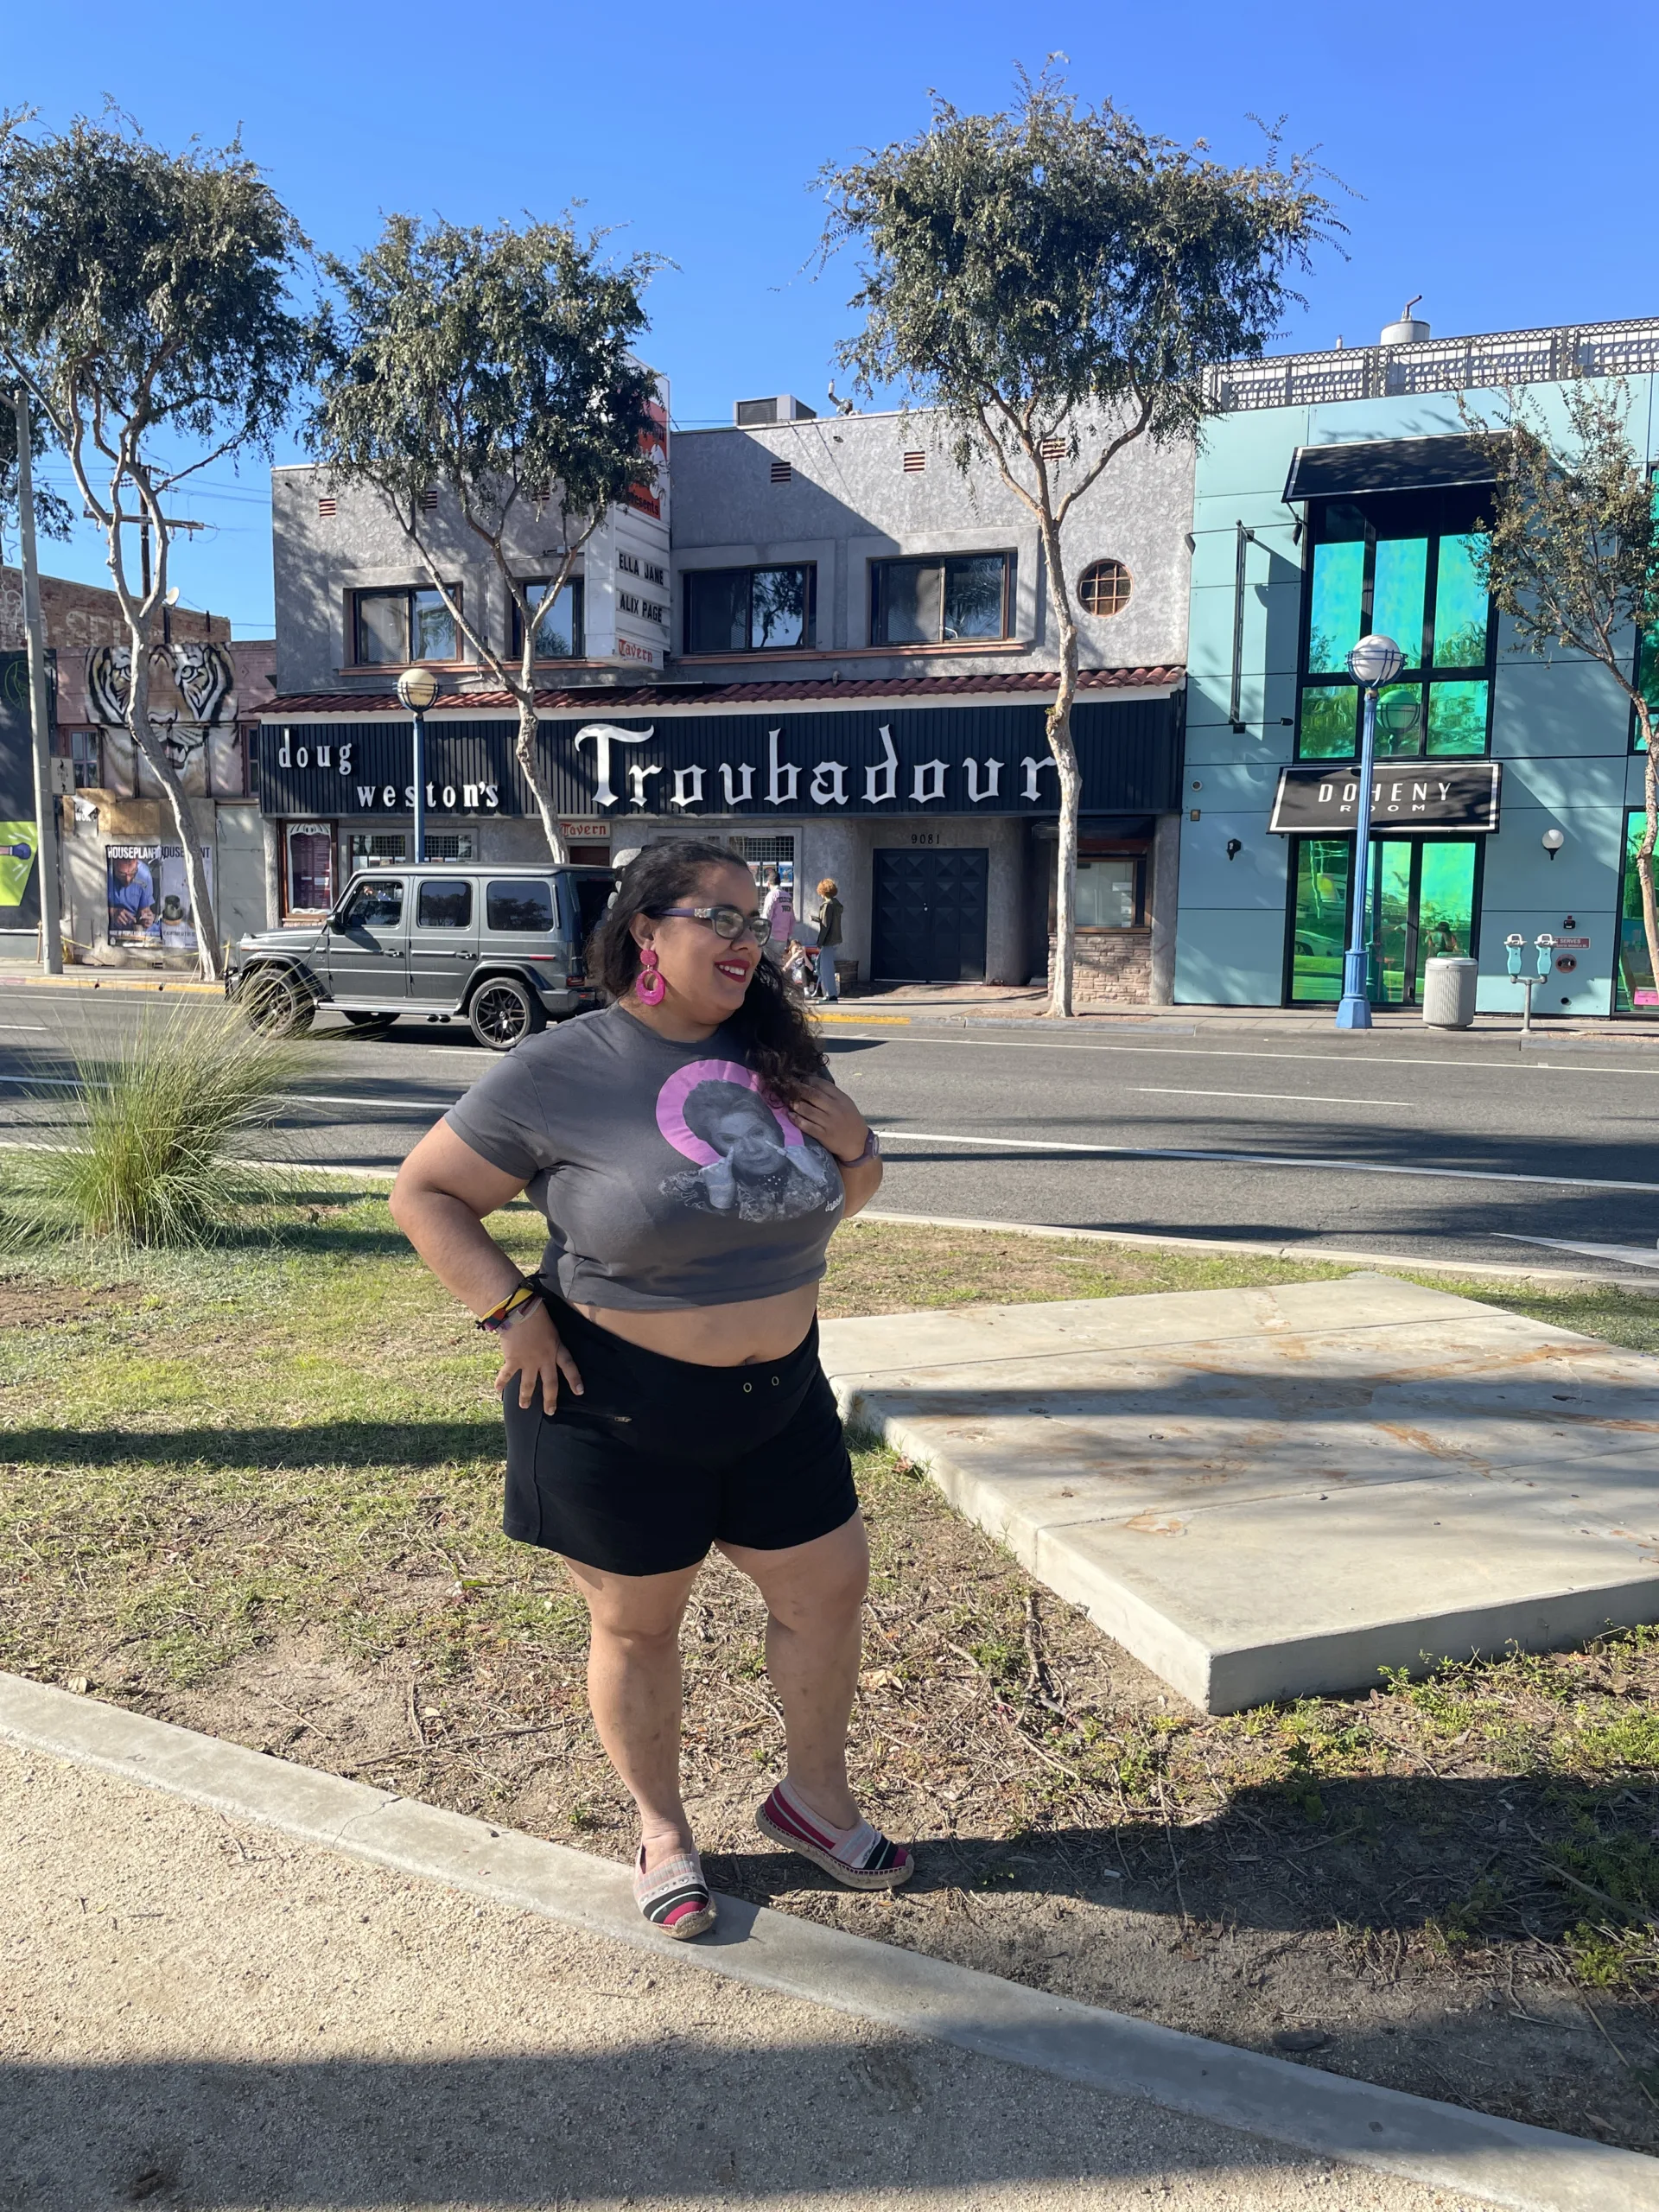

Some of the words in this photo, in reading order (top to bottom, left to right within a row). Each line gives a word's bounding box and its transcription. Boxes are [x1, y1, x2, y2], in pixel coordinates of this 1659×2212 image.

[619, 553, 639, 576] ELLA
[644, 564, 664, 587] JANE
[620, 594, 639, 615] ALIX
[642, 601, 662, 623] PAGE
[618, 639, 653, 664] Tavern
[278, 728, 353, 776] doug
[574, 723, 1058, 806] Troubadour
[356, 780, 500, 808] weston's
[1318, 782, 1452, 803] DOHENY
[560, 823, 607, 837] Tavern
[911, 834, 940, 844] 9081
